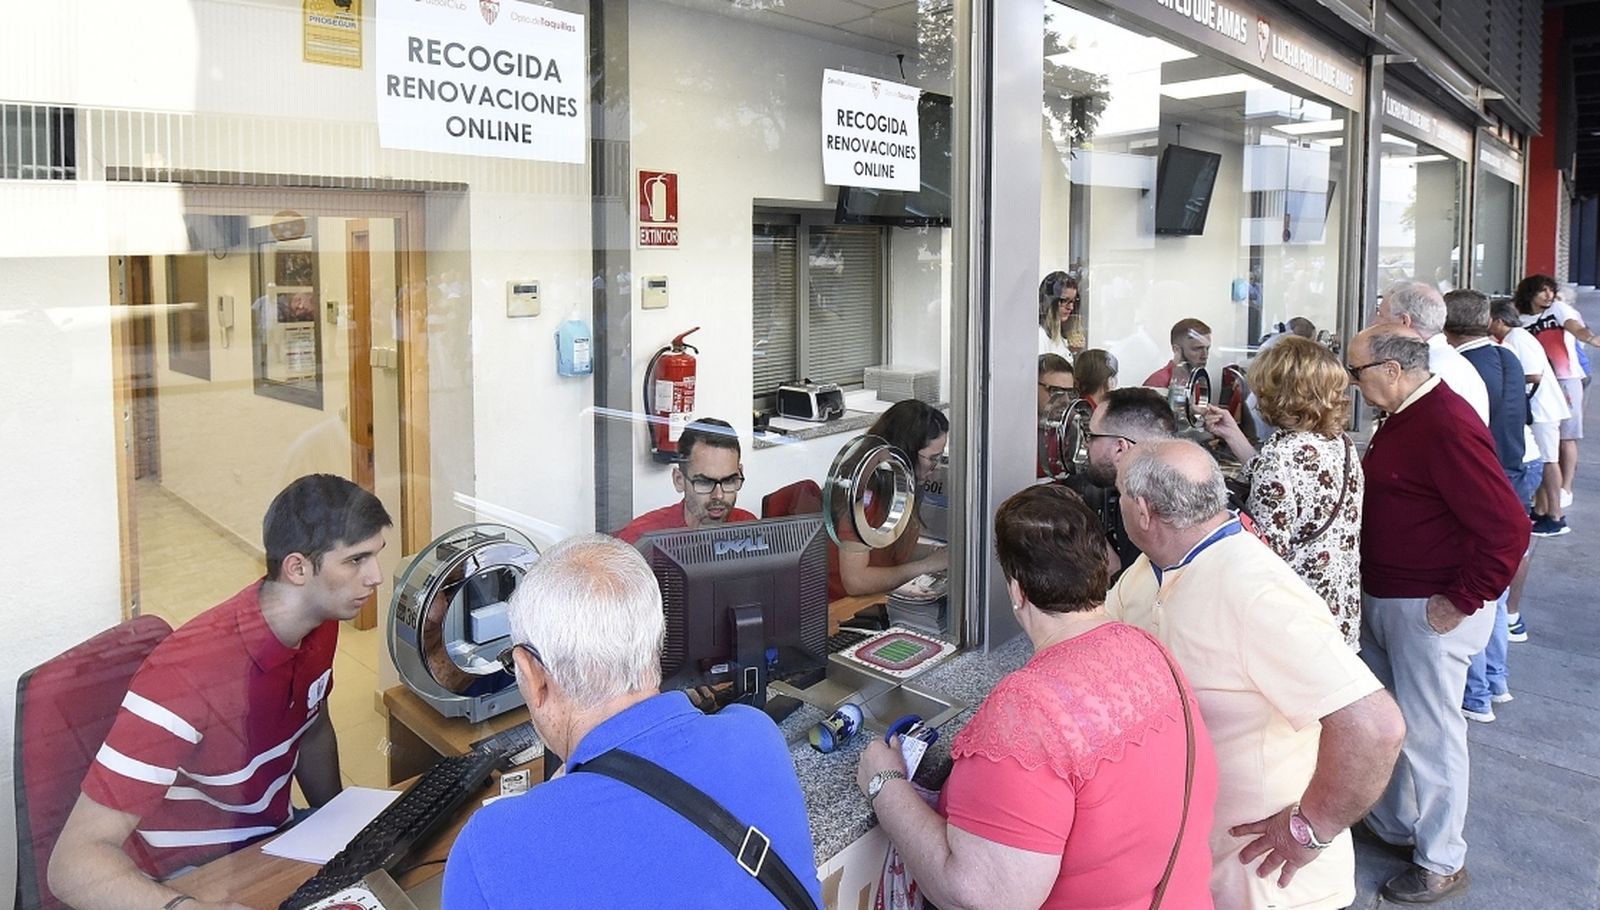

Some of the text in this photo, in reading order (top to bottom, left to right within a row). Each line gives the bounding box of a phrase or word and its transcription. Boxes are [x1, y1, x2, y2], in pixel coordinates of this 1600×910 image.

[1216, 5, 1247, 45] AMAS
[408, 36, 562, 84] RECOGIDA
[386, 74, 578, 118] RENOVACIONES
[446, 115, 532, 145] ONLINE
[837, 108, 908, 136] RECOGIDA
[826, 134, 916, 160] RENOVACIONES
[853, 160, 895, 179] ONLINE
[640, 228, 678, 245] EXTINTOR
[714, 536, 769, 555] DELL
